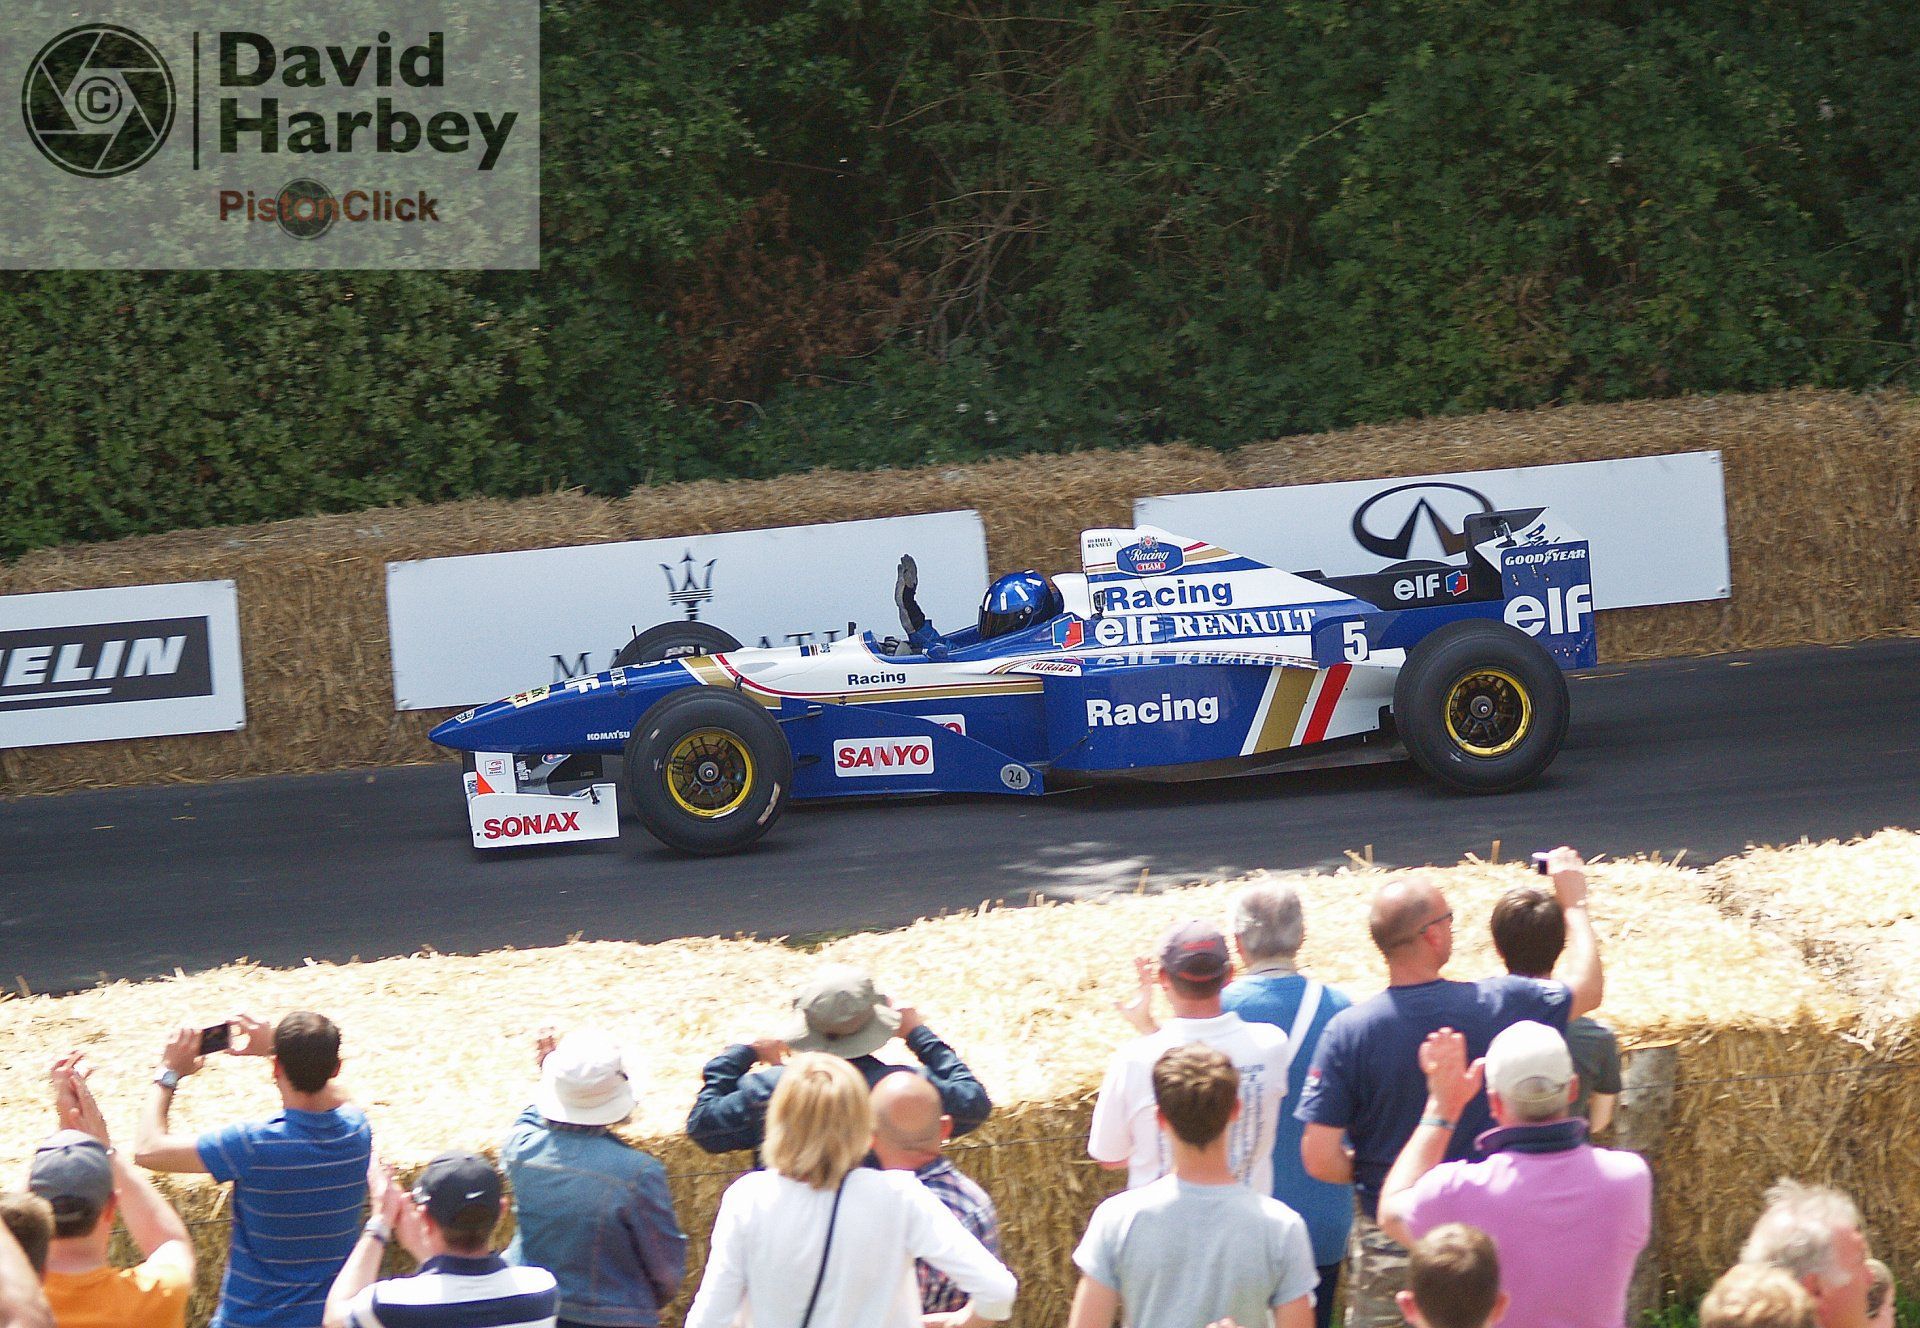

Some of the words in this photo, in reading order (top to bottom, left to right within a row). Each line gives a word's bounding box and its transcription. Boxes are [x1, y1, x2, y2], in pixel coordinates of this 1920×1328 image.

[1129, 548, 1170, 562] Racing
[1141, 562, 1161, 571] TEAM
[1504, 548, 1586, 565] GOODYEAR
[1104, 579, 1233, 612] Racing
[1393, 573, 1440, 601] elf
[1503, 583, 1592, 637] elf
[1094, 614, 1162, 647] elf
[1170, 608, 1316, 638] RENAULT
[1342, 621, 1368, 662] 5
[0, 635, 187, 687] ELIN
[847, 672, 906, 686] Racing
[1086, 693, 1220, 727] Racing
[586, 730, 631, 741] KOMATSU
[837, 744, 930, 769] SANYO
[1008, 769, 1022, 784] 24
[483, 811, 580, 839] SONAX
